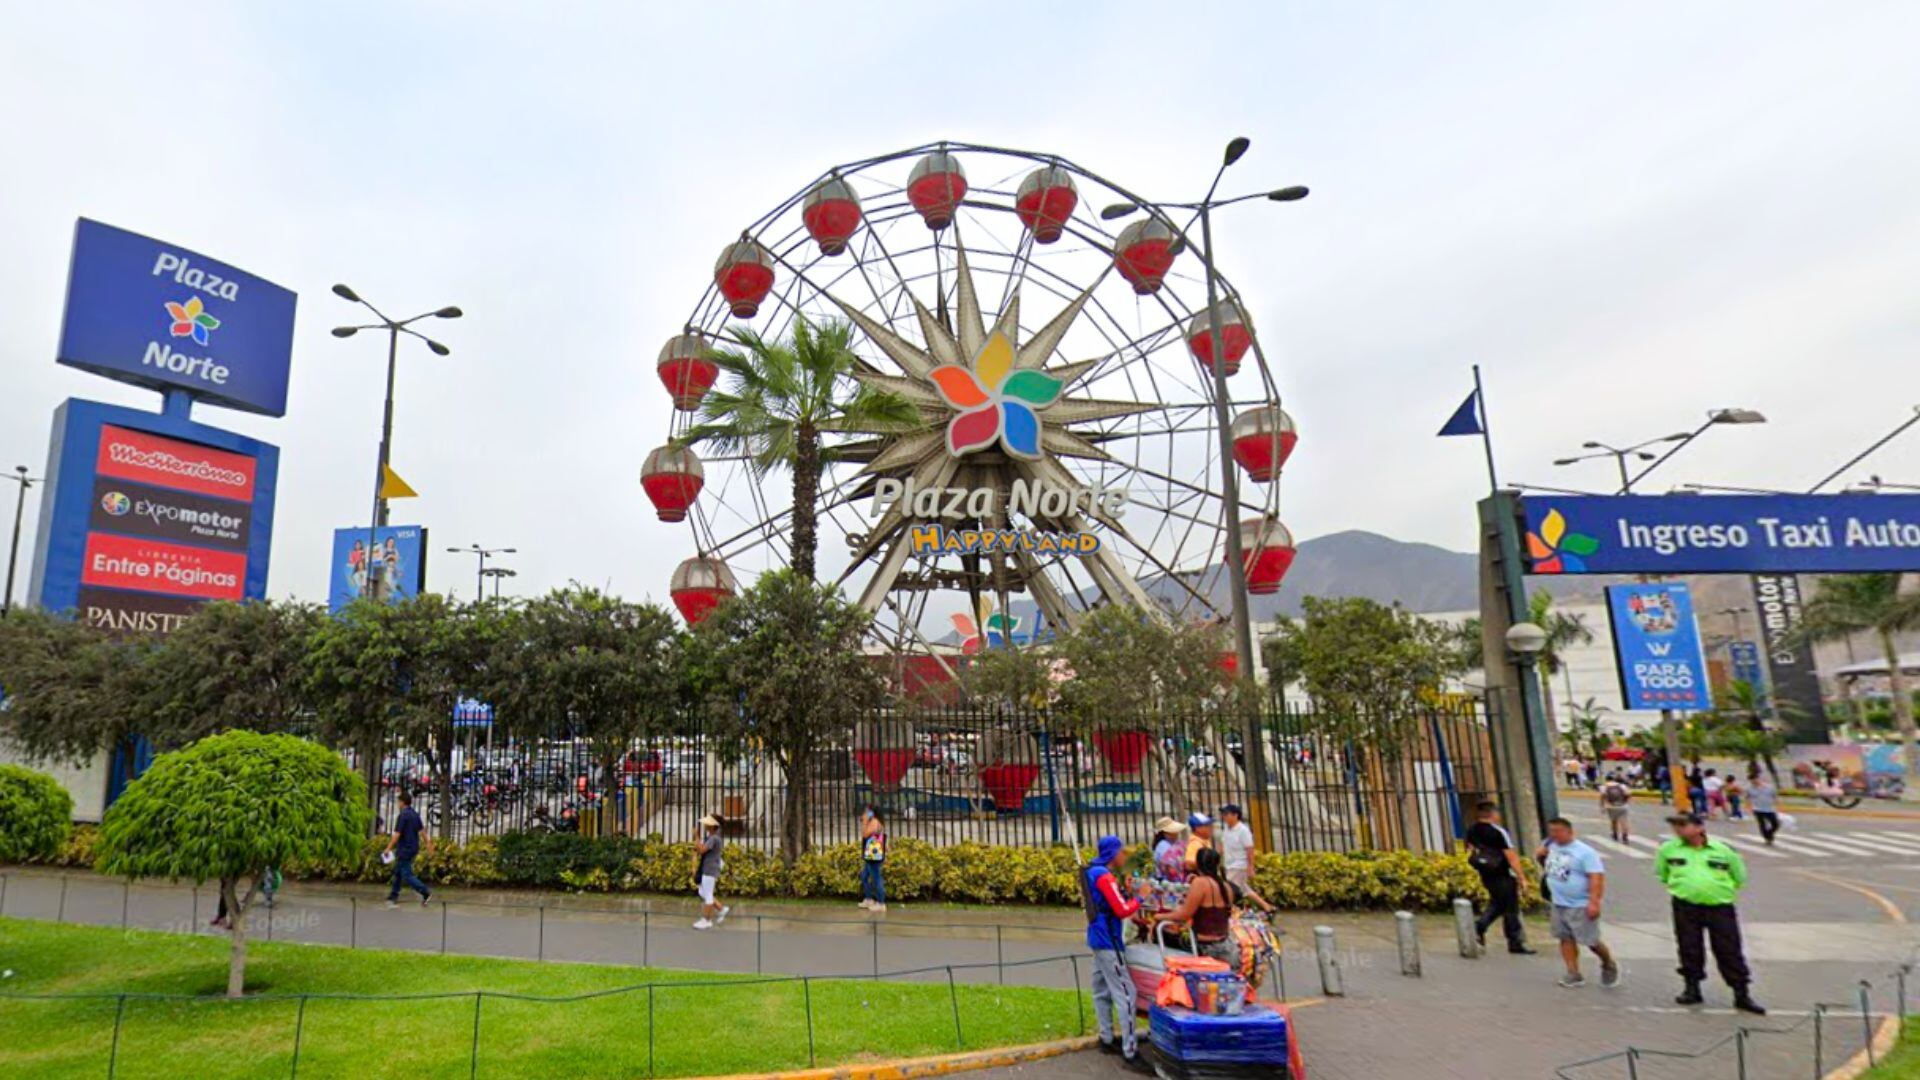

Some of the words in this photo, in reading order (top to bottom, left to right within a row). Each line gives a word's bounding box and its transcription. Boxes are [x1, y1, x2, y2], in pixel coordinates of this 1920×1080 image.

[153, 252, 239, 302] Plaza
[142, 341, 229, 384] Norte
[870, 476, 993, 519] Plaza
[1008, 477, 1130, 519] Norte
[912, 523, 1101, 556] HAPPYLAND
[1618, 518, 1748, 555] Ingreso
[1757, 516, 1833, 547] Taxi
[1845, 517, 1920, 547] Auto
[92, 553, 150, 577] Entre
[153, 561, 237, 586] Páginas
[1634, 664, 1692, 678] PARA
[1638, 676, 1694, 688] TODO
